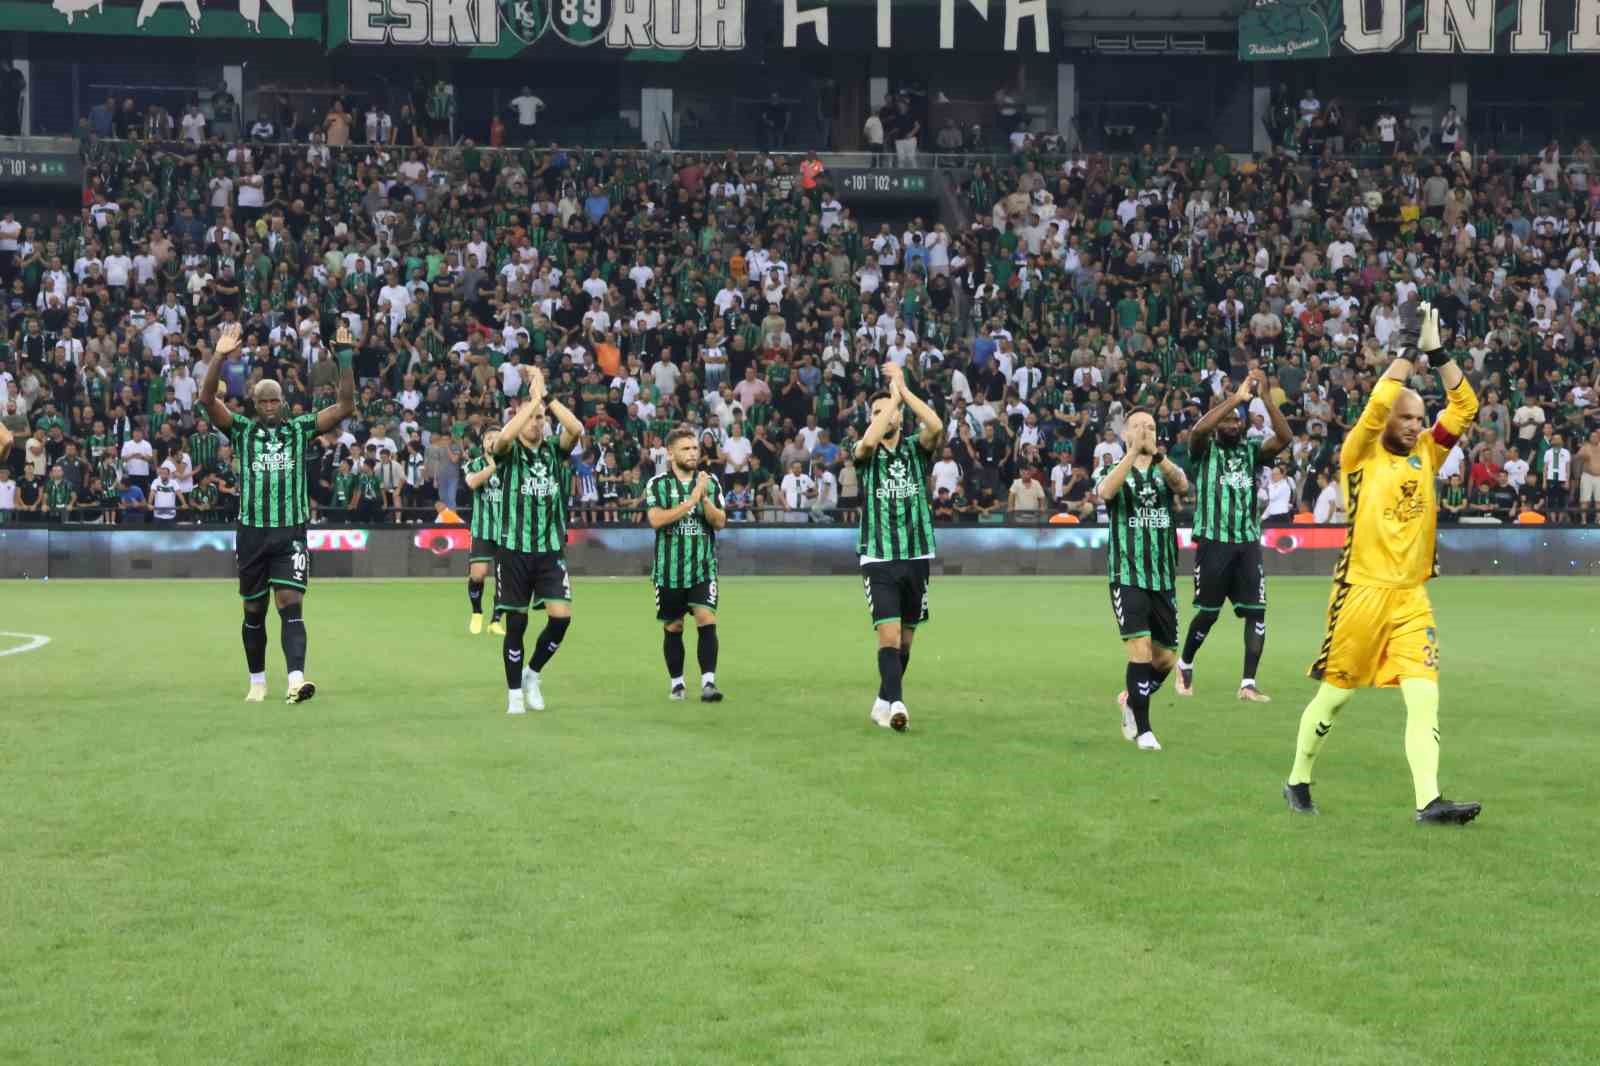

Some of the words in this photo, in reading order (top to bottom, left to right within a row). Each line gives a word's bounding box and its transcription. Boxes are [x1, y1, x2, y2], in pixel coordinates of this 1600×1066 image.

[560, 0, 602, 28] 89
[10, 160, 26, 175] 101
[852, 176, 867, 190] 101
[875, 176, 890, 191] 102
[1128, 517, 1170, 528] ENTEGR
[291, 552, 306, 570] 10
